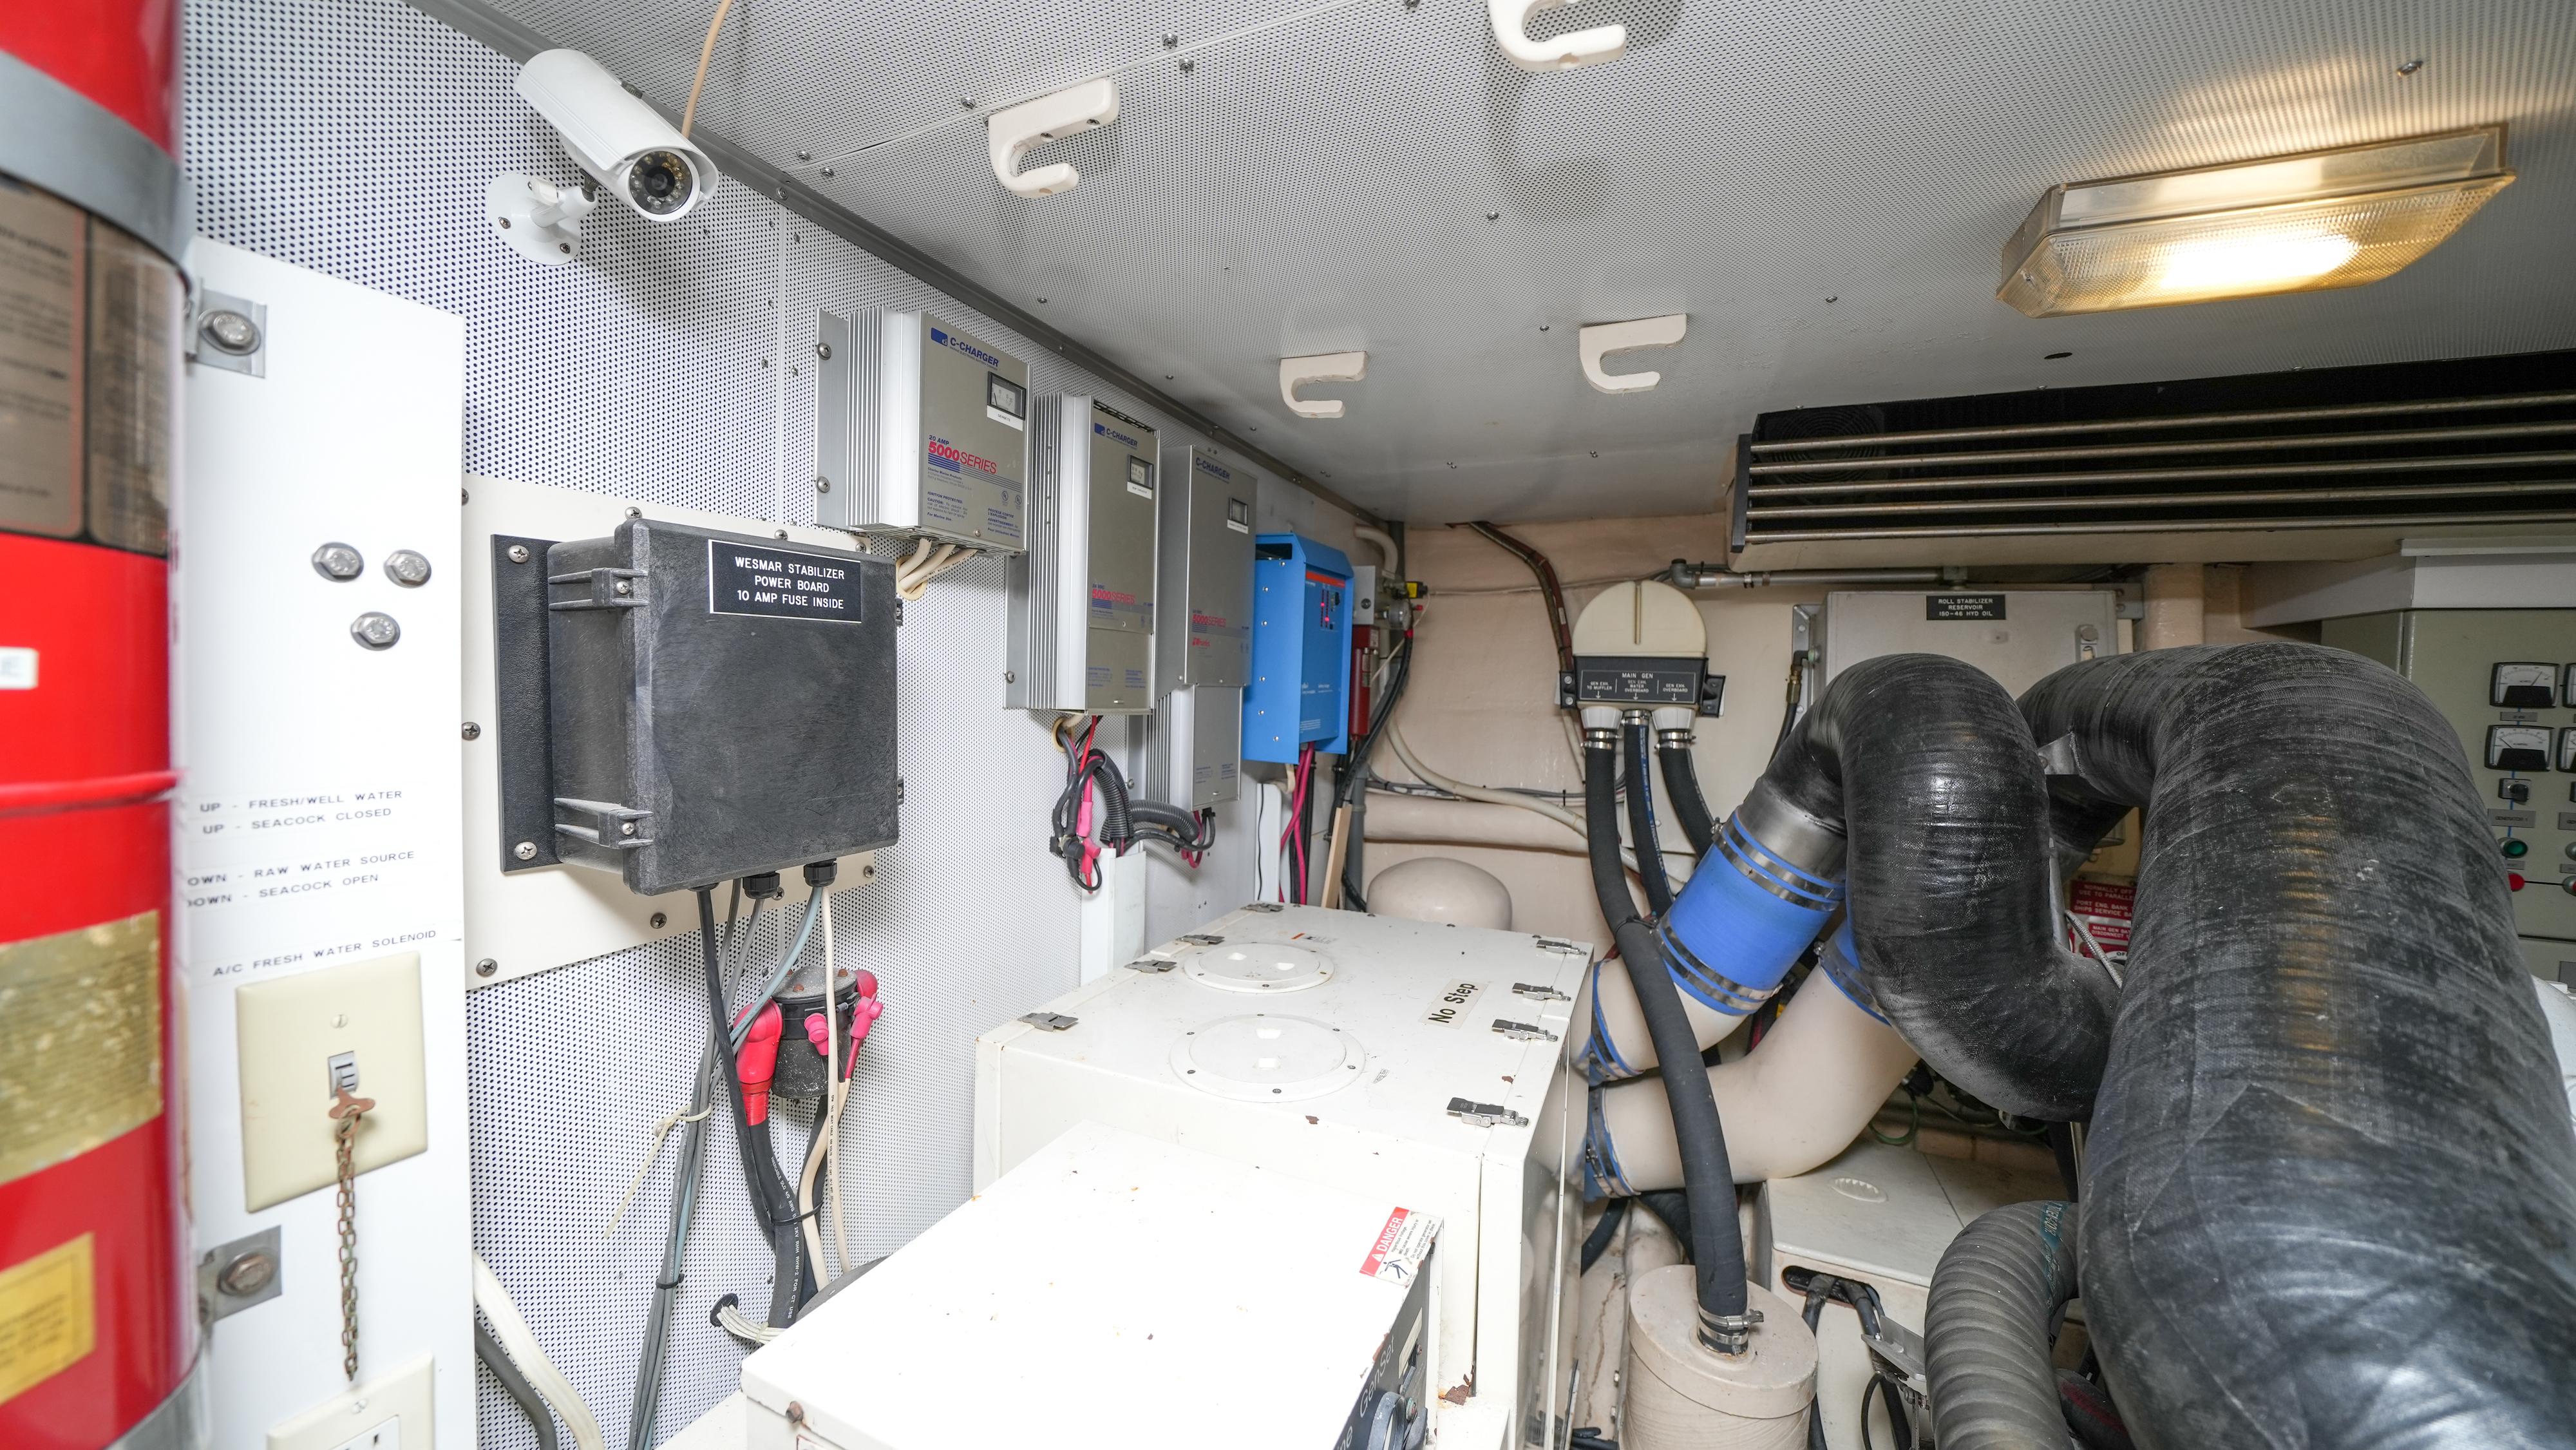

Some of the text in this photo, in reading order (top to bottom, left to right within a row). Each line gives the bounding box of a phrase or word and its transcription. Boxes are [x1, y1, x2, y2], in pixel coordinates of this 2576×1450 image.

[950, 337, 999, 367] C-CHARGER
[1106, 428, 1138, 447] C-CHARGER
[1196, 457, 1231, 480] C-CHARGER
[735, 556, 844, 580] WESMAR STABILIZER
[755, 575, 829, 593] POWER BOARD
[737, 590, 844, 609] 10 AMP FUSE INSIDE
[200, 803, 221, 813] UP
[249, 796, 344, 810] FRESH/WELL
[355, 790, 402, 801] WATER
[203, 824, 224, 835] UP
[251, 814, 326, 830] SEACOCK
[336, 808, 392, 821] CLOSED
[187, 873, 227, 886] OWN
[254, 866, 289, 878] RAW
[300, 858, 350, 872] WATER
[360, 851, 415, 865] SOURCE
[259, 880, 332, 898] SEACOCK
[342, 873, 379, 886] OPEN
[2095, 908, 2121, 916] SERVICE
[213, 930, 437, 977] A/C FRESH WATER SOLENOID
[1428, 984, 1479, 1023] No Step
[1376, 1217, 1403, 1252] DANGER
[1416, 1238, 1424, 1248] operate
[1421, 1224, 1430, 1238] generator
[791, 1295, 796, 1303] CT
[1360, 1334, 1394, 1418] GenSet
